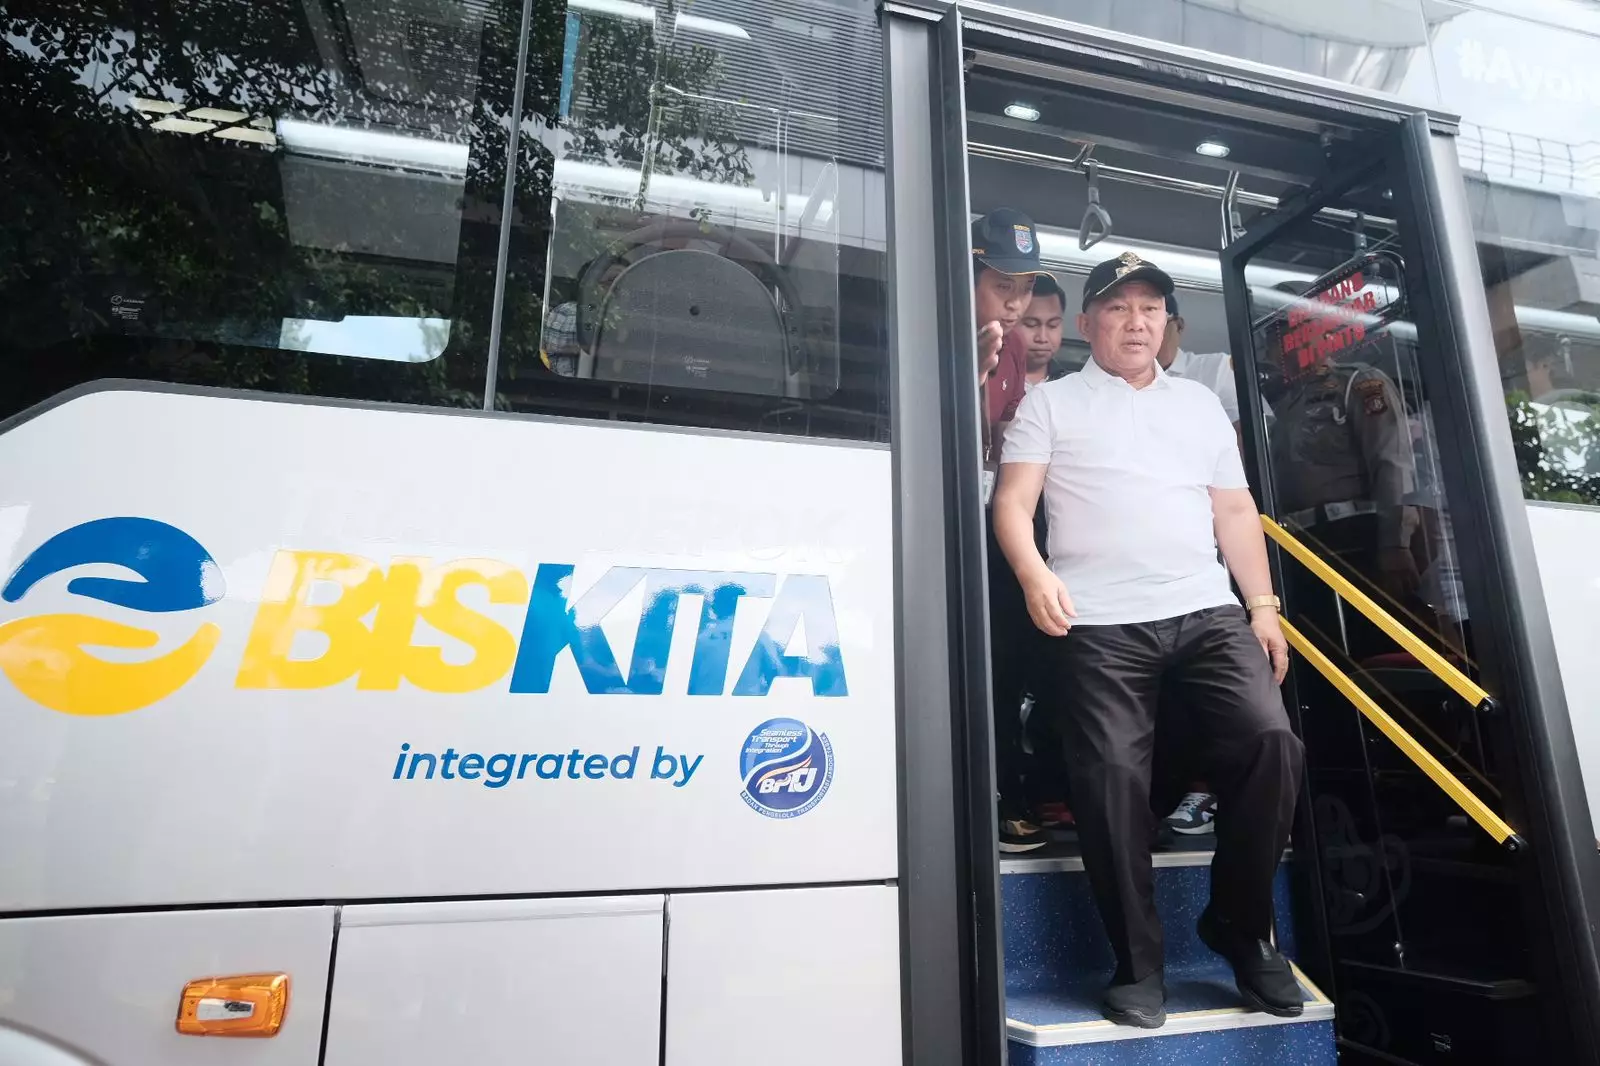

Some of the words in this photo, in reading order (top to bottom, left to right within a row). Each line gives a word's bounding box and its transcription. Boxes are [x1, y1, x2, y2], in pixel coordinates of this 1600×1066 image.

[234, 549, 849, 698] BISKITA
[751, 735, 797, 743] Transport
[760, 729, 803, 737] Seamless
[392, 742, 640, 788] integrated
[650, 745, 704, 787] by
[741, 791, 759, 810] BADAN
[758, 807, 795, 819] PENGELOLA
[797, 779, 830, 815] TRANSPORTASI
